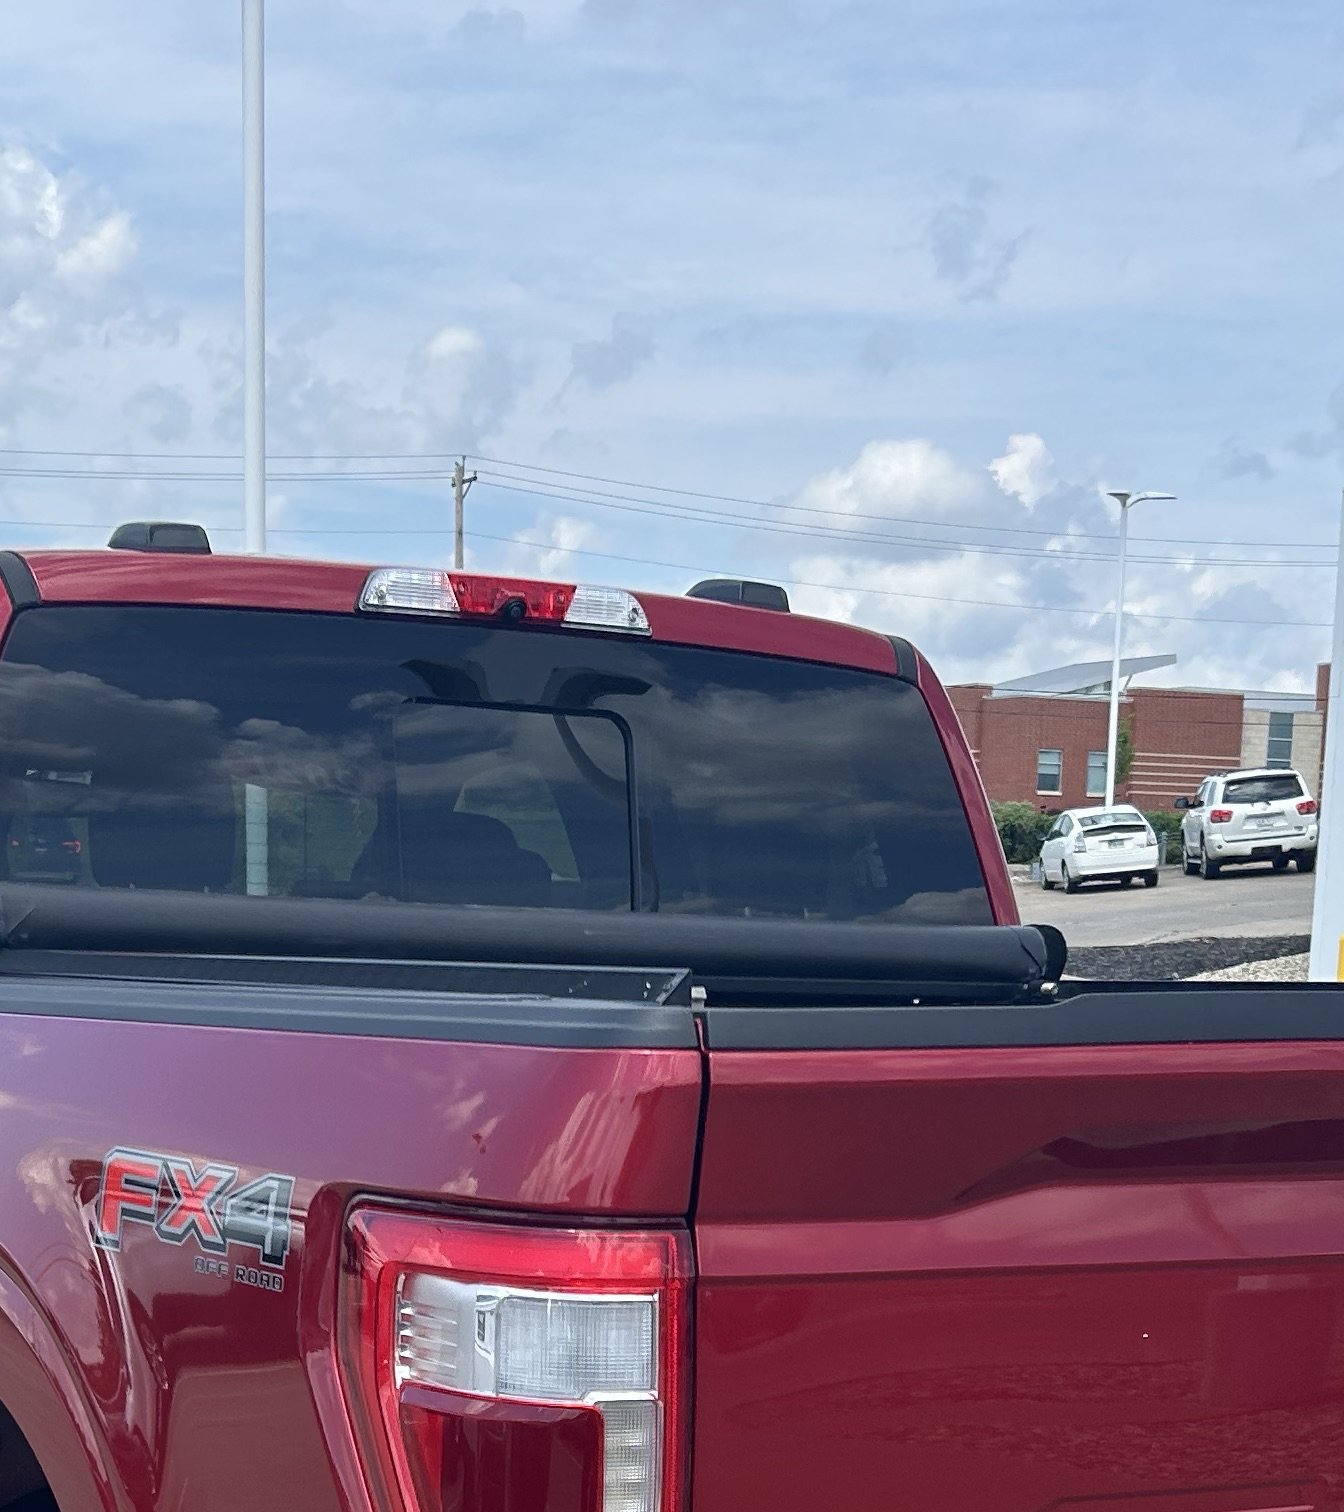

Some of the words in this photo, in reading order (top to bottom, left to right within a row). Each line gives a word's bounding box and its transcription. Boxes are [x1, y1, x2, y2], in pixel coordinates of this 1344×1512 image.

[94, 1145, 296, 1269] FX4
[193, 1256, 229, 1279] OFF
[235, 1264, 285, 1293] ROAD
